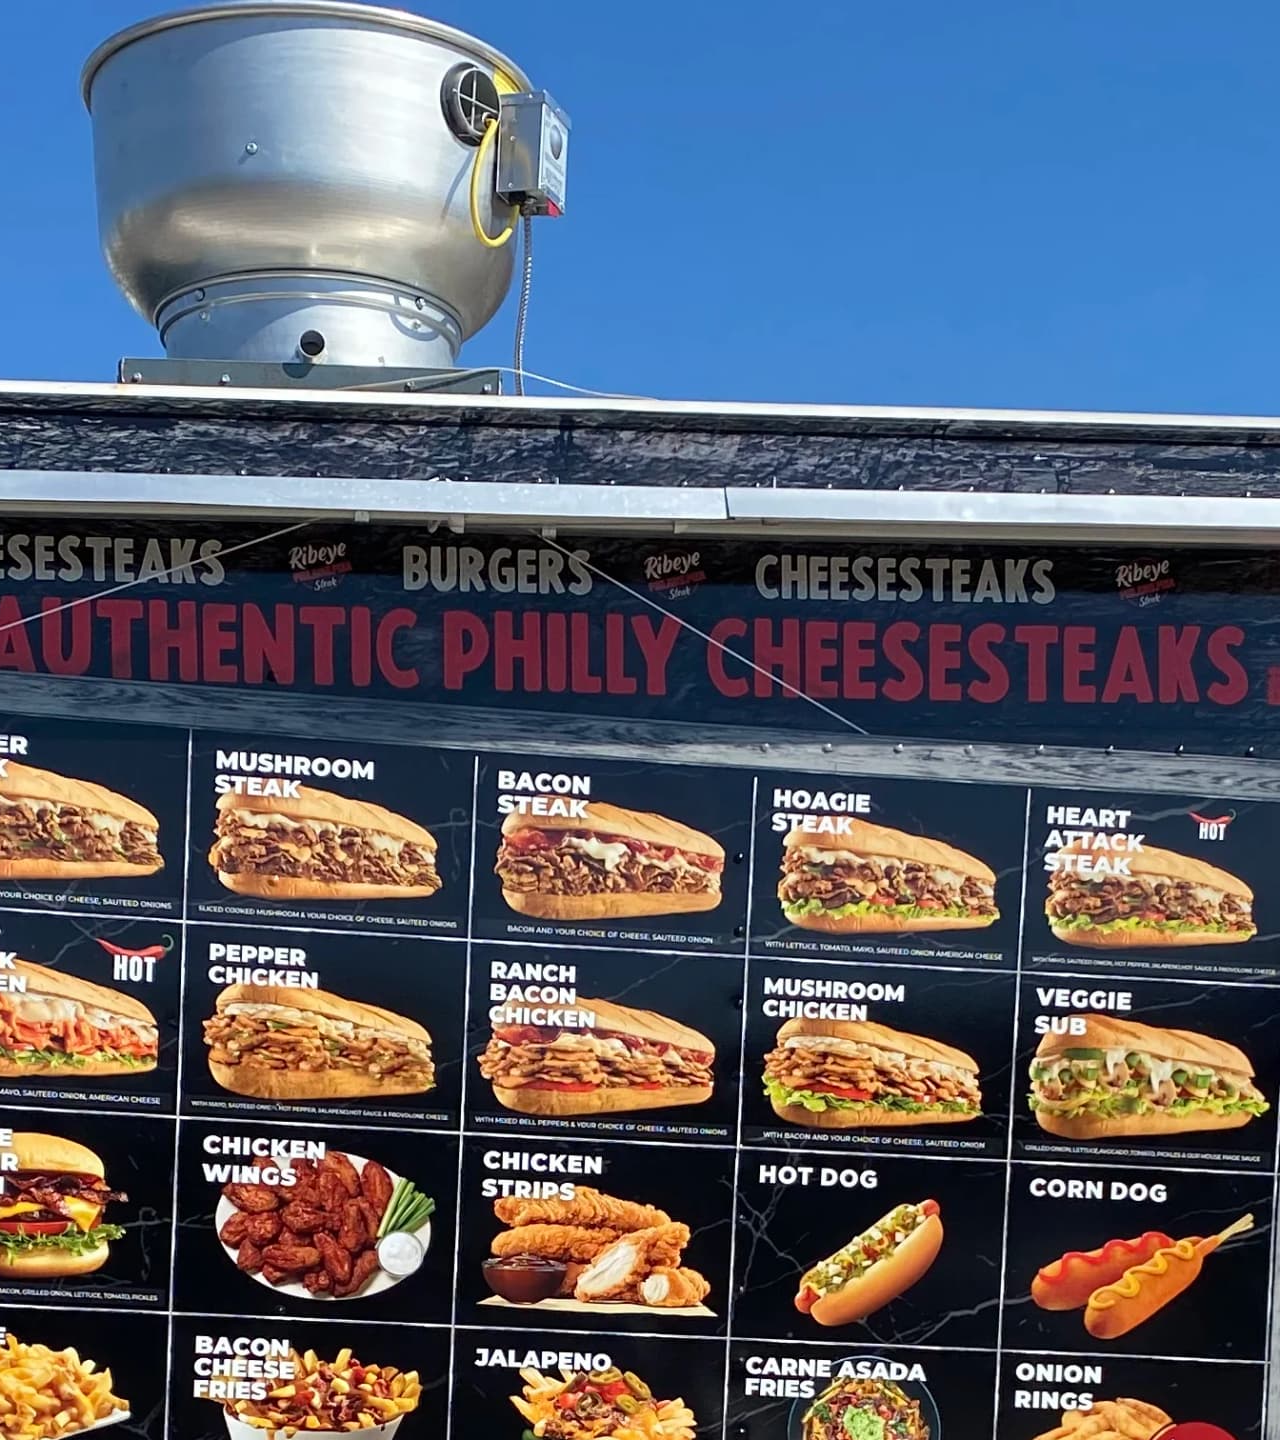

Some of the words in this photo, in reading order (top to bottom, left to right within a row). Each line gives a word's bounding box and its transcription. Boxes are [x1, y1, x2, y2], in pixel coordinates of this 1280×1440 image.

[403, 545, 593, 595] BURGERS
[755, 553, 1055, 605] CHEESESTEAKS
[443, 609, 682, 697] PHILLY
[708, 616, 1250, 705] CHEESESTEAKS
[214, 749, 375, 781] MUSHROOM
[214, 774, 301, 799] STEAK
[497, 769, 591, 796] BACON
[496, 793, 589, 819] STEAK
[772, 788, 871, 814] HOAGIE
[771, 812, 854, 836] STEAK
[1046, 805, 1131, 829] HEART
[1044, 828, 1145, 853] ATTACK
[1198, 821, 1227, 841] HOT
[1043, 851, 1132, 876] STEAK
[208, 943, 306, 967] PEPPER
[113, 954, 157, 983] HOT
[208, 964, 319, 990] CHICKEN
[490, 960, 577, 985] RANCH
[489, 982, 577, 1006] BACON
[763, 977, 905, 1002] MUSHROOM
[1036, 986, 1132, 1011] VEGGIE
[488, 1004, 596, 1029] CHICKEN
[762, 998, 868, 1022] CHICKEN
[1034, 1014, 1087, 1036] SUB
[202, 1134, 326, 1160] CHICKEN
[202, 1162, 297, 1188] WINGS
[482, 1149, 603, 1176] CHICKEN
[758, 1164, 815, 1186] HOT
[820, 1166, 878, 1189] DOG
[481, 1178, 576, 1202] STRIPS
[1029, 1177, 1104, 1200] CORN
[1110, 1179, 1168, 1202] DOG
[194, 1335, 289, 1359] BACON
[193, 1356, 295, 1381] CHEESE
[474, 1347, 612, 1373] JALAPENO
[745, 1356, 832, 1379] CARNE
[837, 1359, 926, 1382] ASADA
[1015, 1363, 1103, 1385] ONION
[192, 1378, 267, 1401] FRIES
[744, 1376, 815, 1399] FRIES
[1014, 1389, 1094, 1411] RINGS
